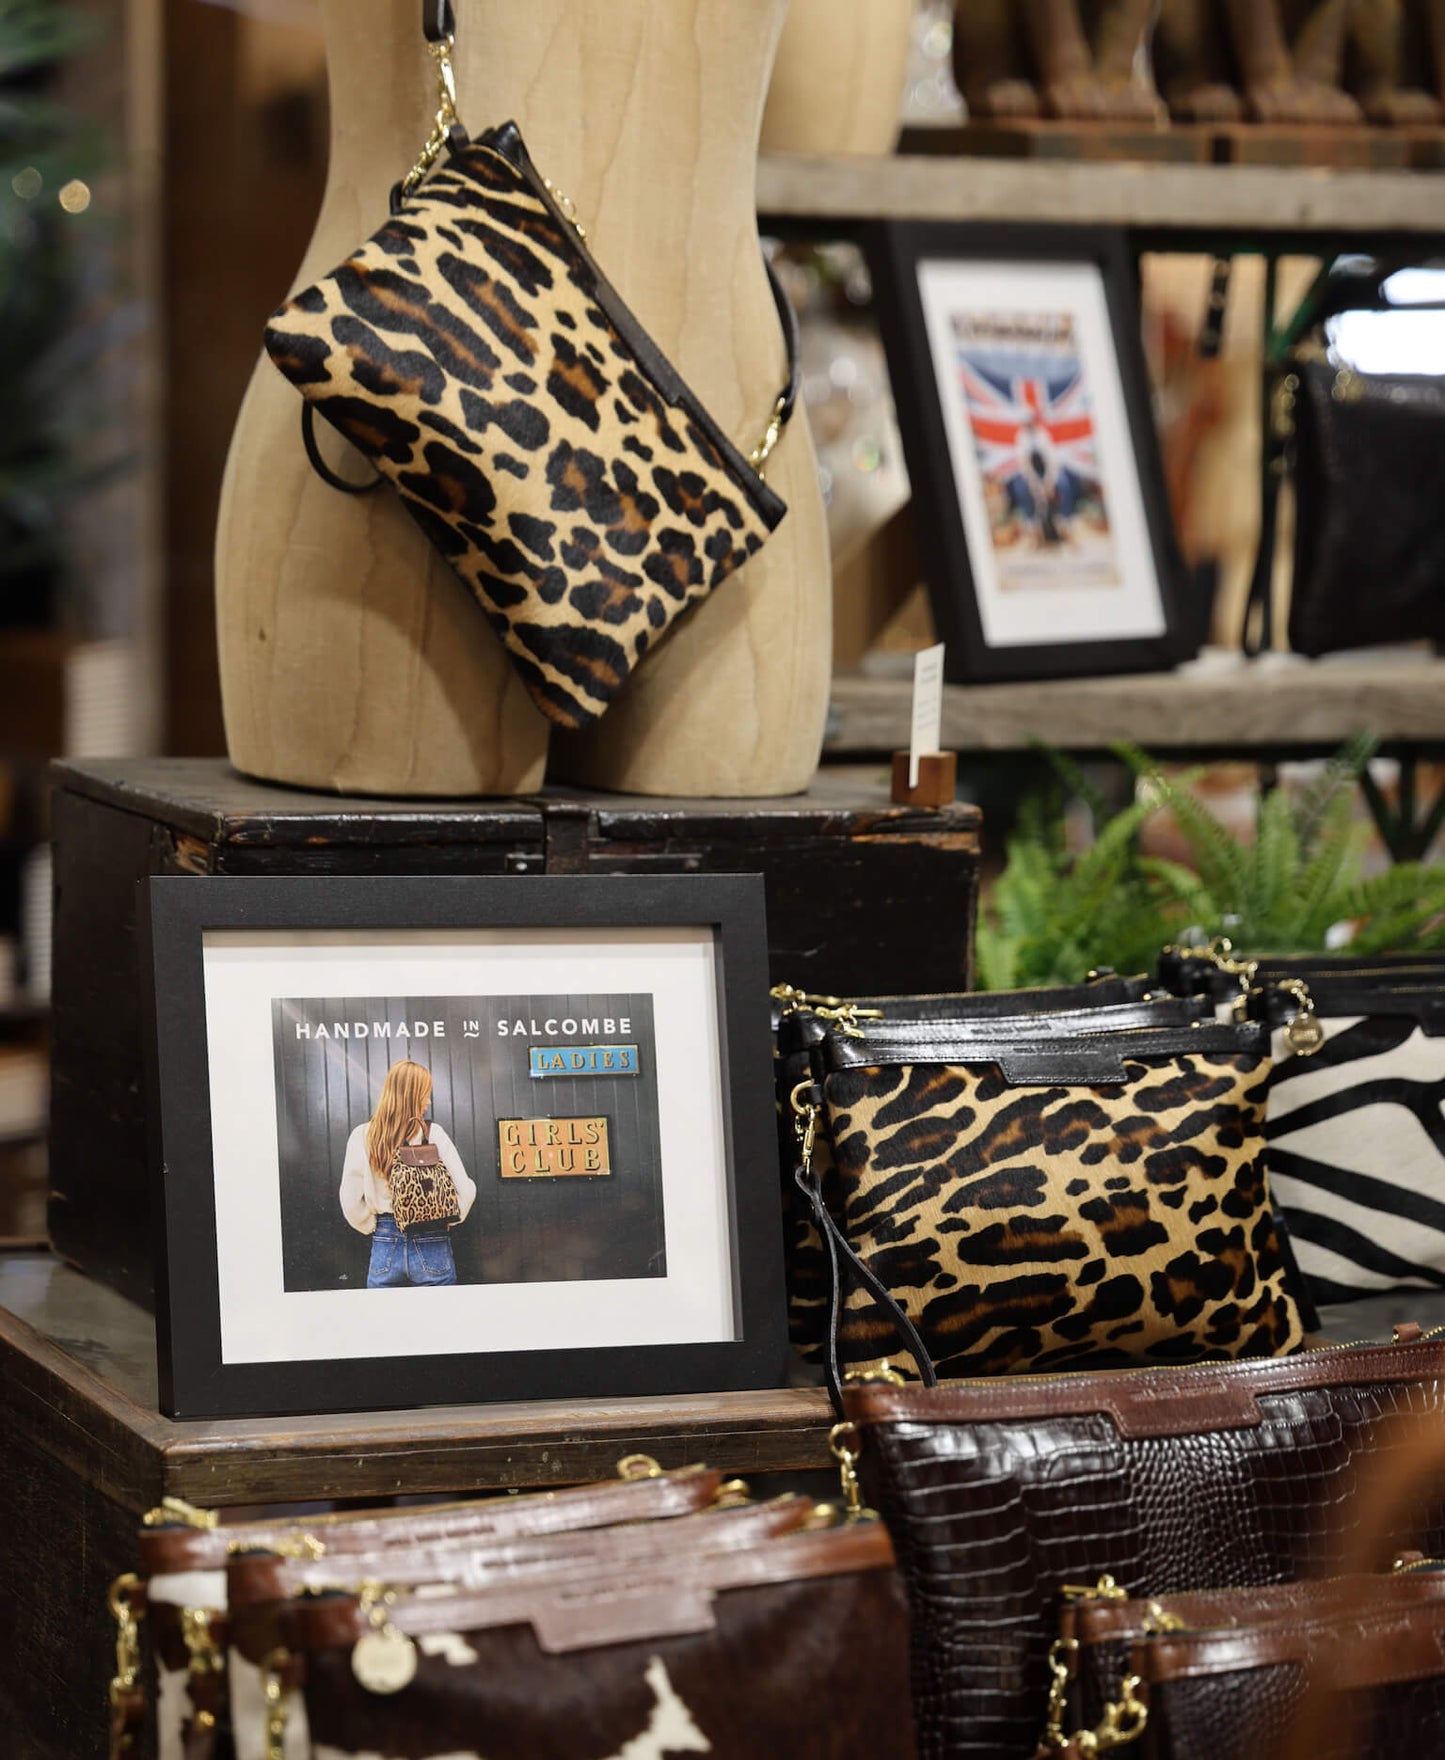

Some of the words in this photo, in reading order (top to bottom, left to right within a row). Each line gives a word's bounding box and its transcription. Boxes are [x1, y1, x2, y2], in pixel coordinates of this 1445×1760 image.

[295, 1021, 446, 1039] HANDMADE
[463, 1020, 480, 1032] IN
[497, 1018, 632, 1036] SALCOMBE
[537, 1052, 630, 1070] LADIES
[511, 1148, 601, 1173] CLUB
